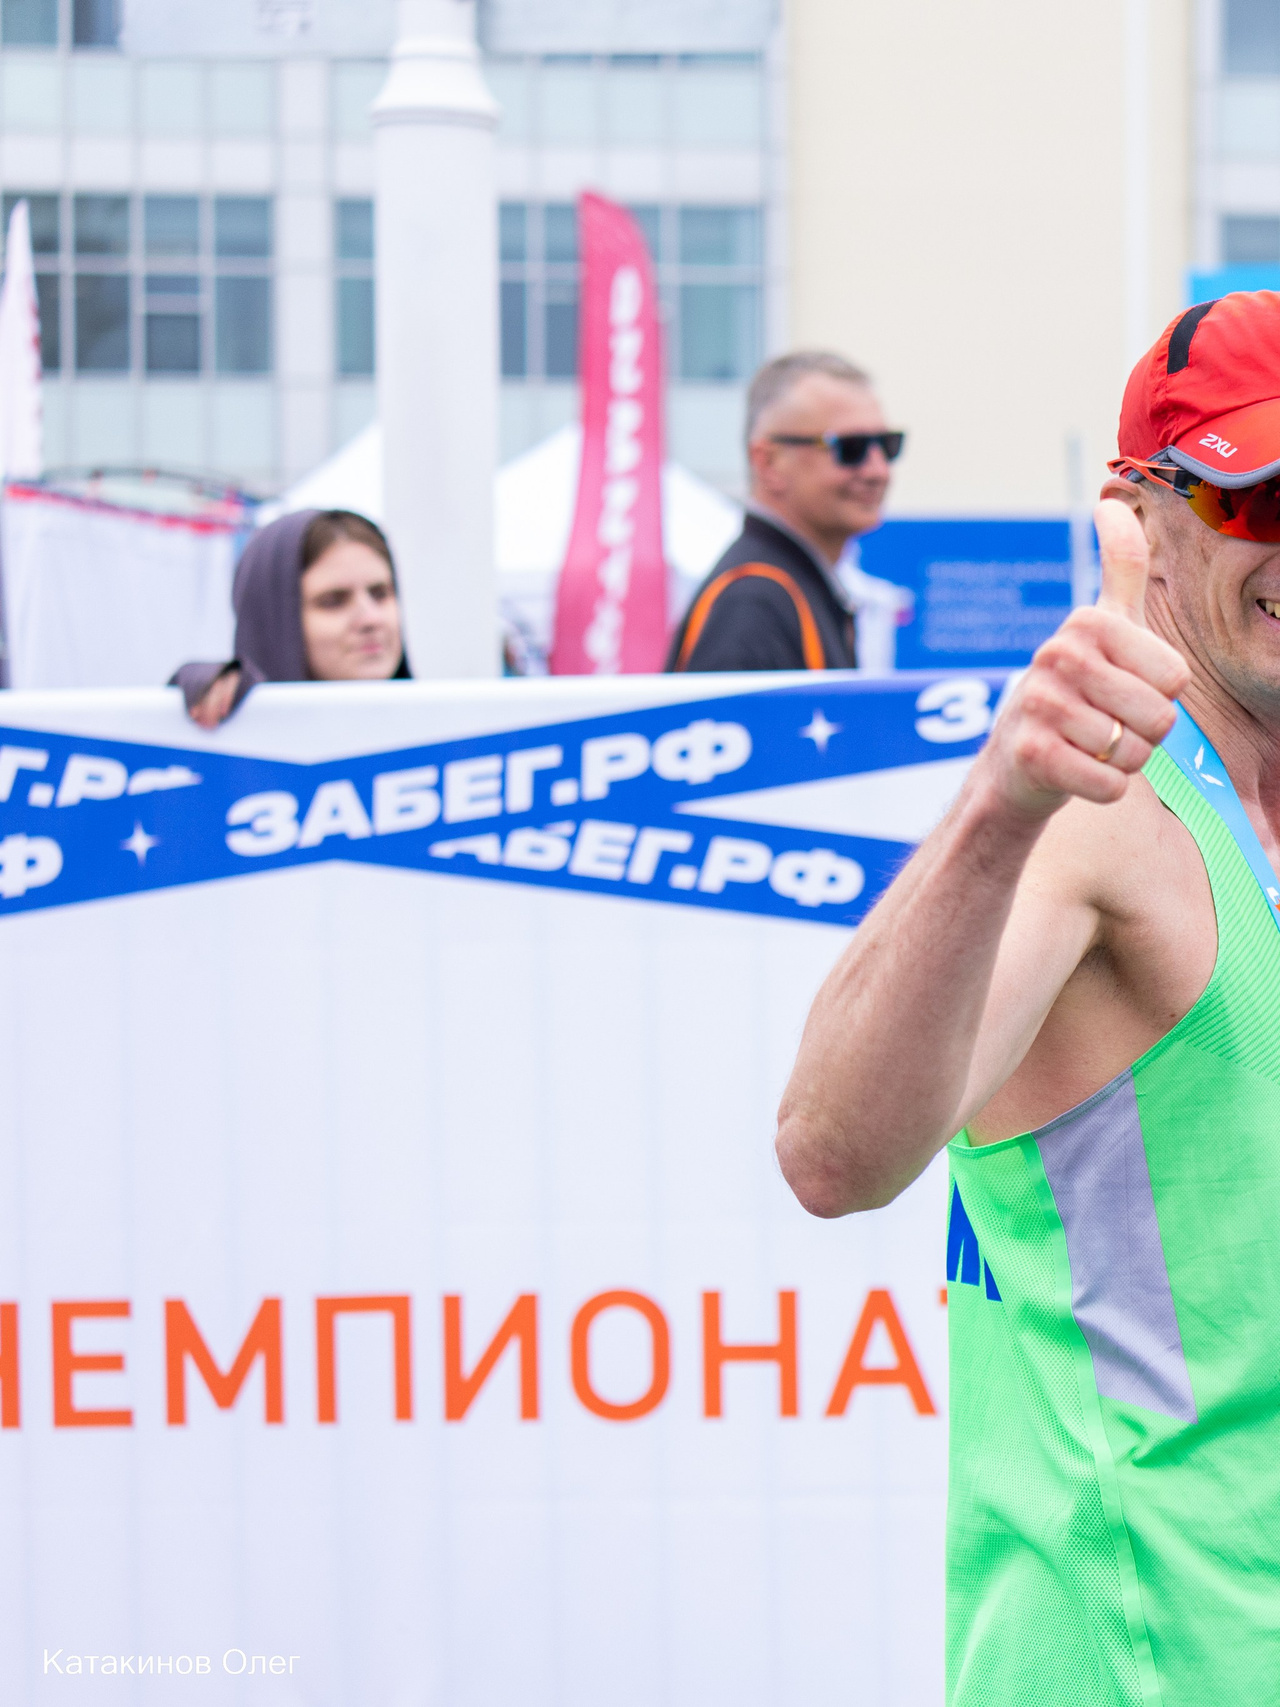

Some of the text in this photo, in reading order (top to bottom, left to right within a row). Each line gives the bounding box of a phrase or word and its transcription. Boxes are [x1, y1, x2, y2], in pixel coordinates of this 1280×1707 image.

[1198, 432, 1238, 458] 2XU
[226, 719, 751, 857] ЗАБЕГ.РФ
[0, 1288, 948, 1430] ЕМПИОНА
